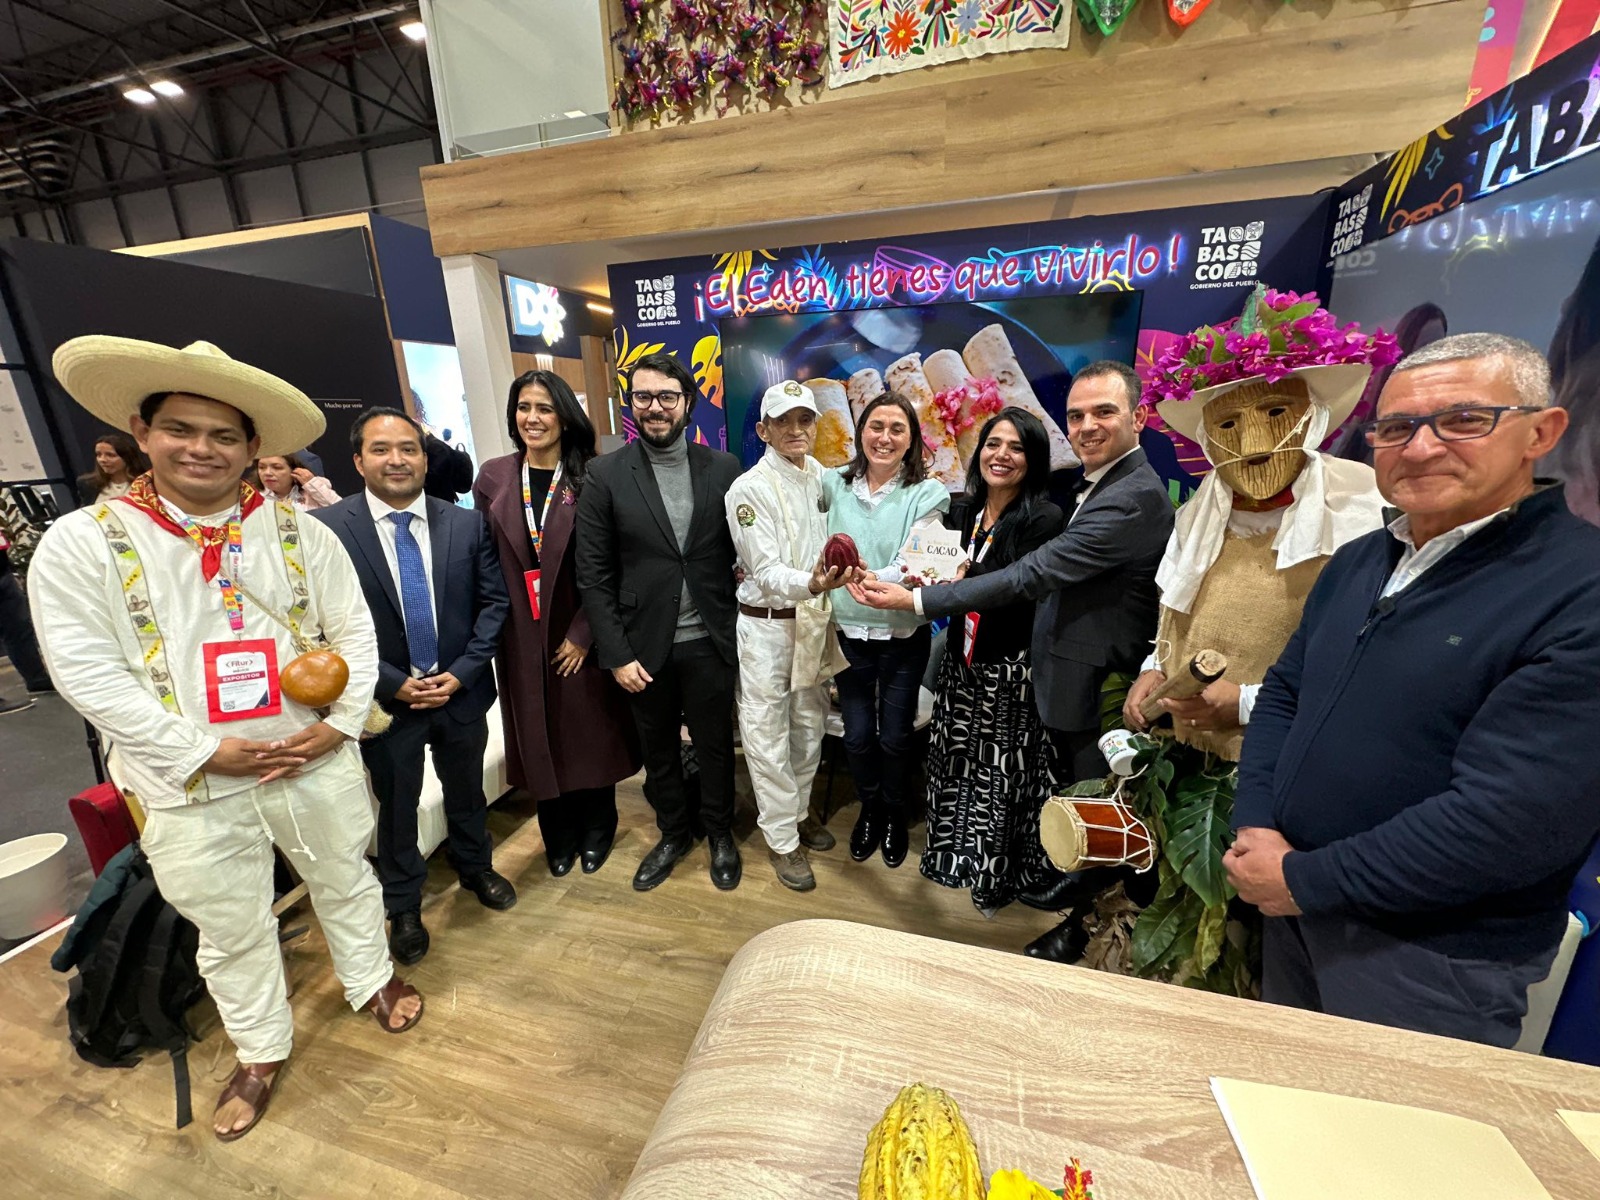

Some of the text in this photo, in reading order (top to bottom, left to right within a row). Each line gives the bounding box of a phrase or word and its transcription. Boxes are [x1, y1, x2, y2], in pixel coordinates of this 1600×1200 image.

[1339, 198, 1351, 219] TA
[1201, 226, 1227, 245] TA
[1333, 213, 1356, 239] BAS
[1197, 244, 1240, 263] BAS
[1330, 238, 1345, 258] CO
[846, 261, 944, 299] tienes
[954, 256, 1020, 300] que
[1195, 263, 1224, 281] CO
[635, 279, 653, 292] TA
[636, 292, 663, 307] BAS
[638, 307, 656, 321] CO
[927, 544, 958, 557] CACAO
[222, 673, 260, 682] EXPOSITOR
[933, 779, 960, 848] VOGUE
